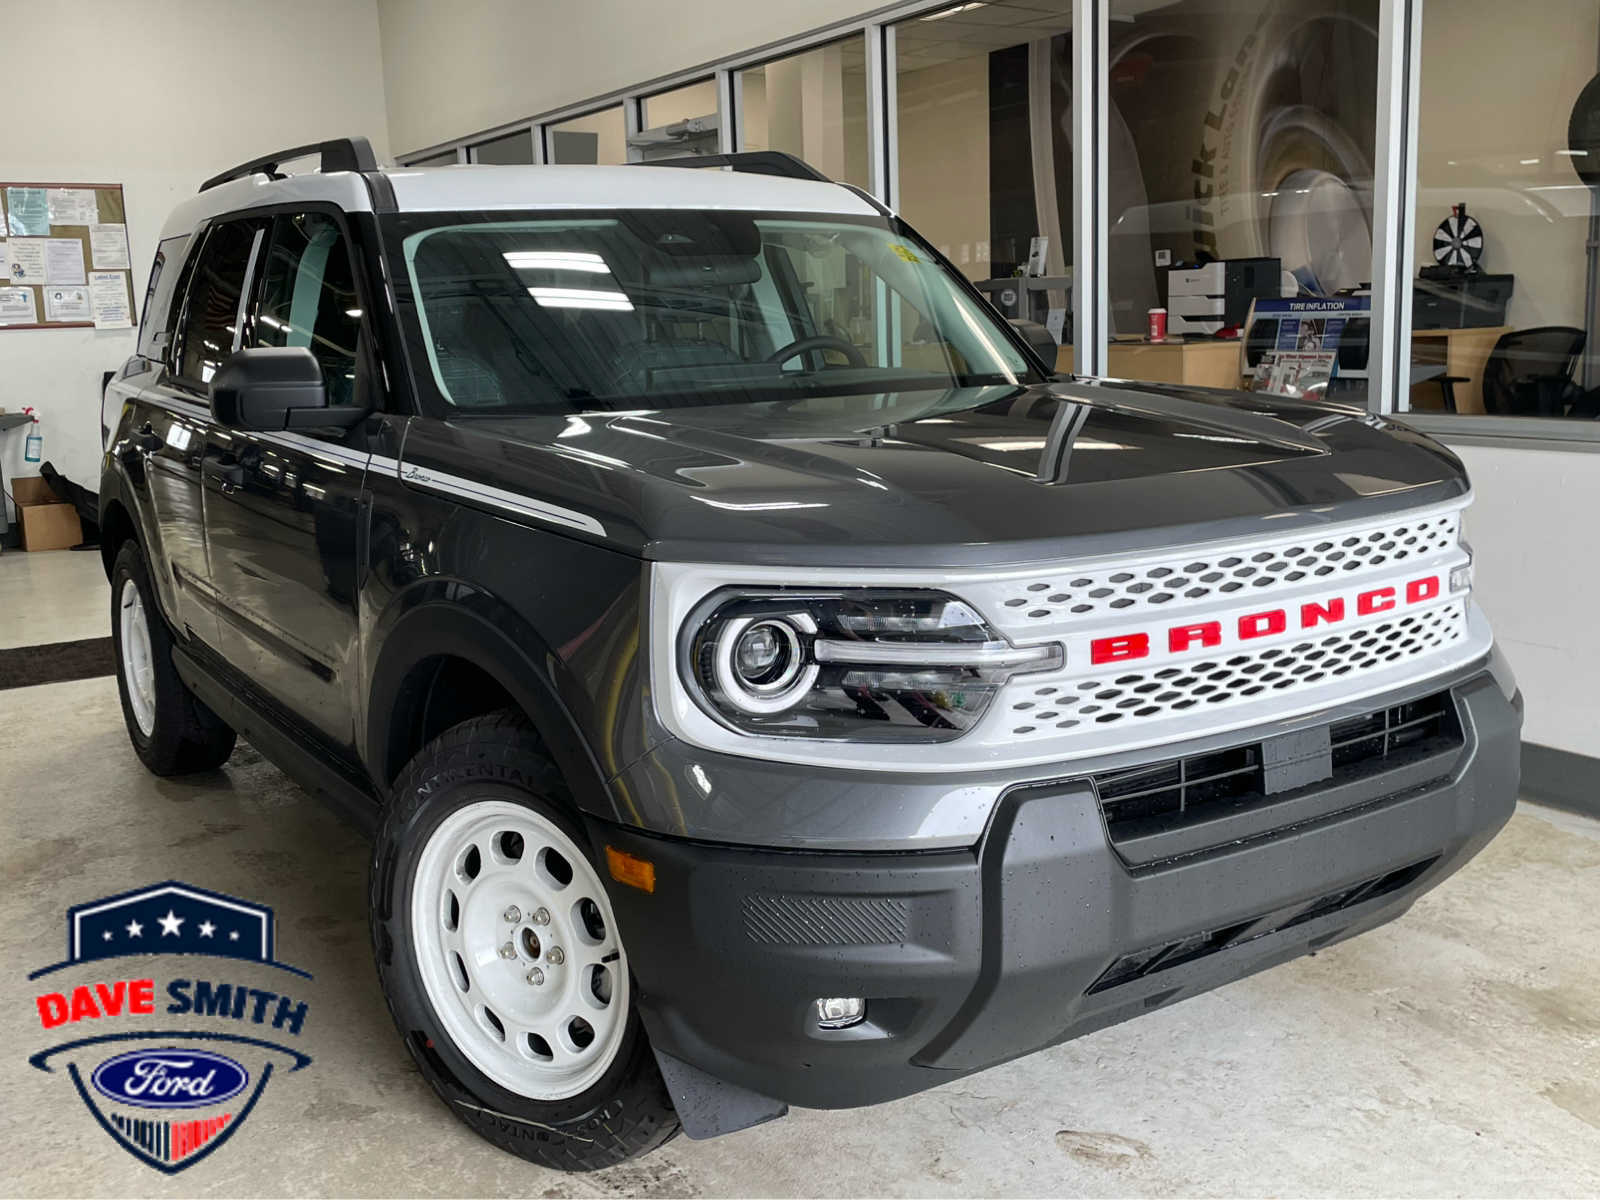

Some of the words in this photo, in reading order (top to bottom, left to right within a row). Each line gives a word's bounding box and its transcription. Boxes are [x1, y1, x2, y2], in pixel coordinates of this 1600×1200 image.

[1185, 144, 1220, 262] uick
[1289, 302, 1305, 311] TIRE
[1306, 301, 1345, 311] INFLATION
[1090, 576, 1440, 665] BRONCO
